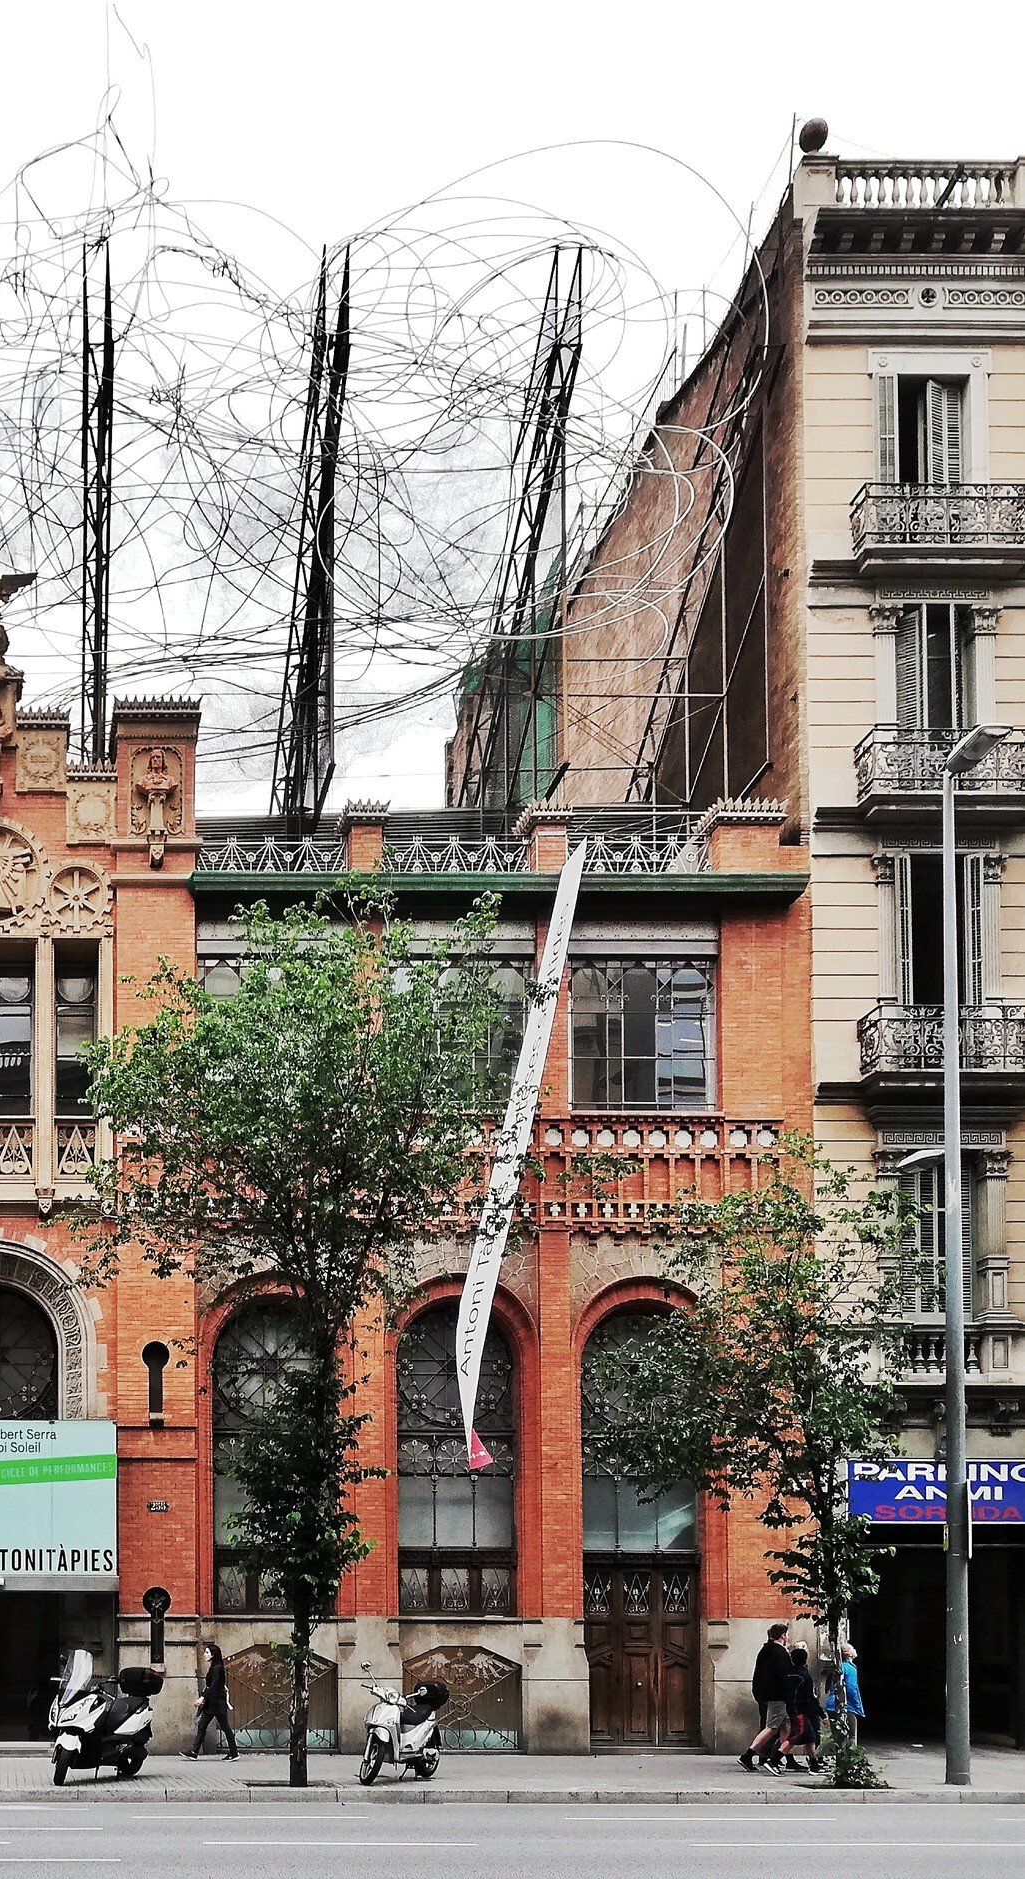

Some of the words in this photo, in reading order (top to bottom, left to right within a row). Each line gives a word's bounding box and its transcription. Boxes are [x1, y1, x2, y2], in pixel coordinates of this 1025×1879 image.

[460, 1280, 485, 1377] Antoni
[26, 1428, 57, 1440] Serra
[10, 1441, 41, 1453] Soleil
[0, 1466, 25, 1479] CICLE
[29, 1465, 39, 1477] DE
[42, 1461, 114, 1476] PERFORMANCES
